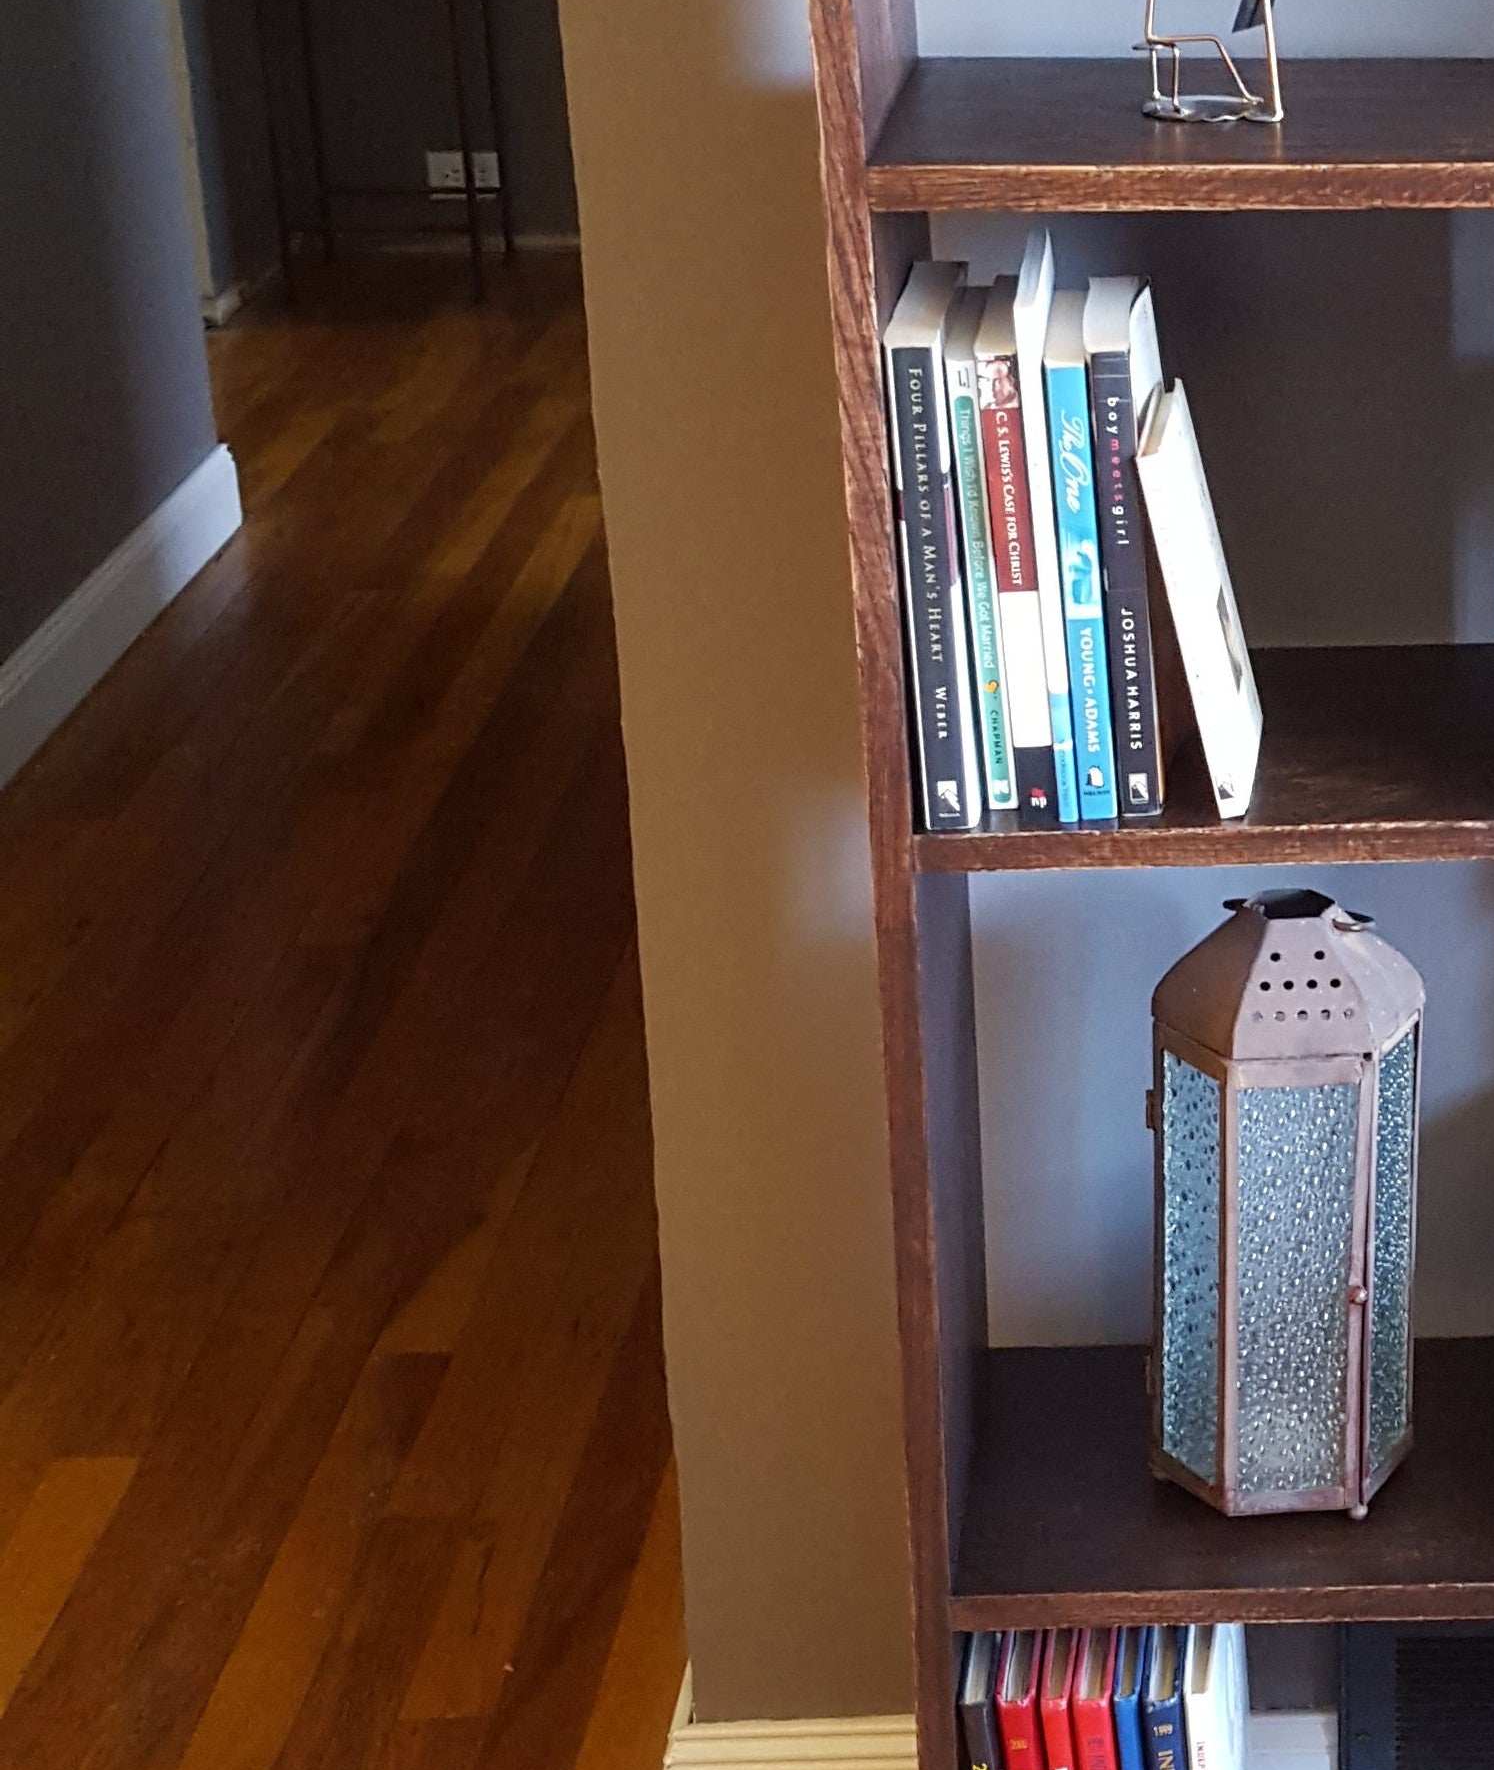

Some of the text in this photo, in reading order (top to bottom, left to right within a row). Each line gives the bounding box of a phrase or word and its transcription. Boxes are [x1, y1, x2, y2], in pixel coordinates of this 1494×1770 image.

[958, 409, 971, 445] Things
[996, 412, 1008, 423] C.
[997, 427, 1007, 437] S.
[1060, 409, 1091, 514] The One
[1002, 486, 1016, 513] CASE
[1006, 517, 1019, 539] FOR
[908, 368, 948, 739] FOUR PILLARS OF A MAN'S HEART WEBER
[971, 540, 986, 578] Before
[1008, 542, 1023, 586] CHRIST
[974, 583, 988, 600] We
[976, 603, 990, 622] Got
[980, 625, 995, 669] Married
[1080, 627, 1100, 753] YOUNG ADAMS
[1121, 608, 1143, 750] JOSHUA HARRIS
[990, 710, 1001, 764] CHAPMAN
